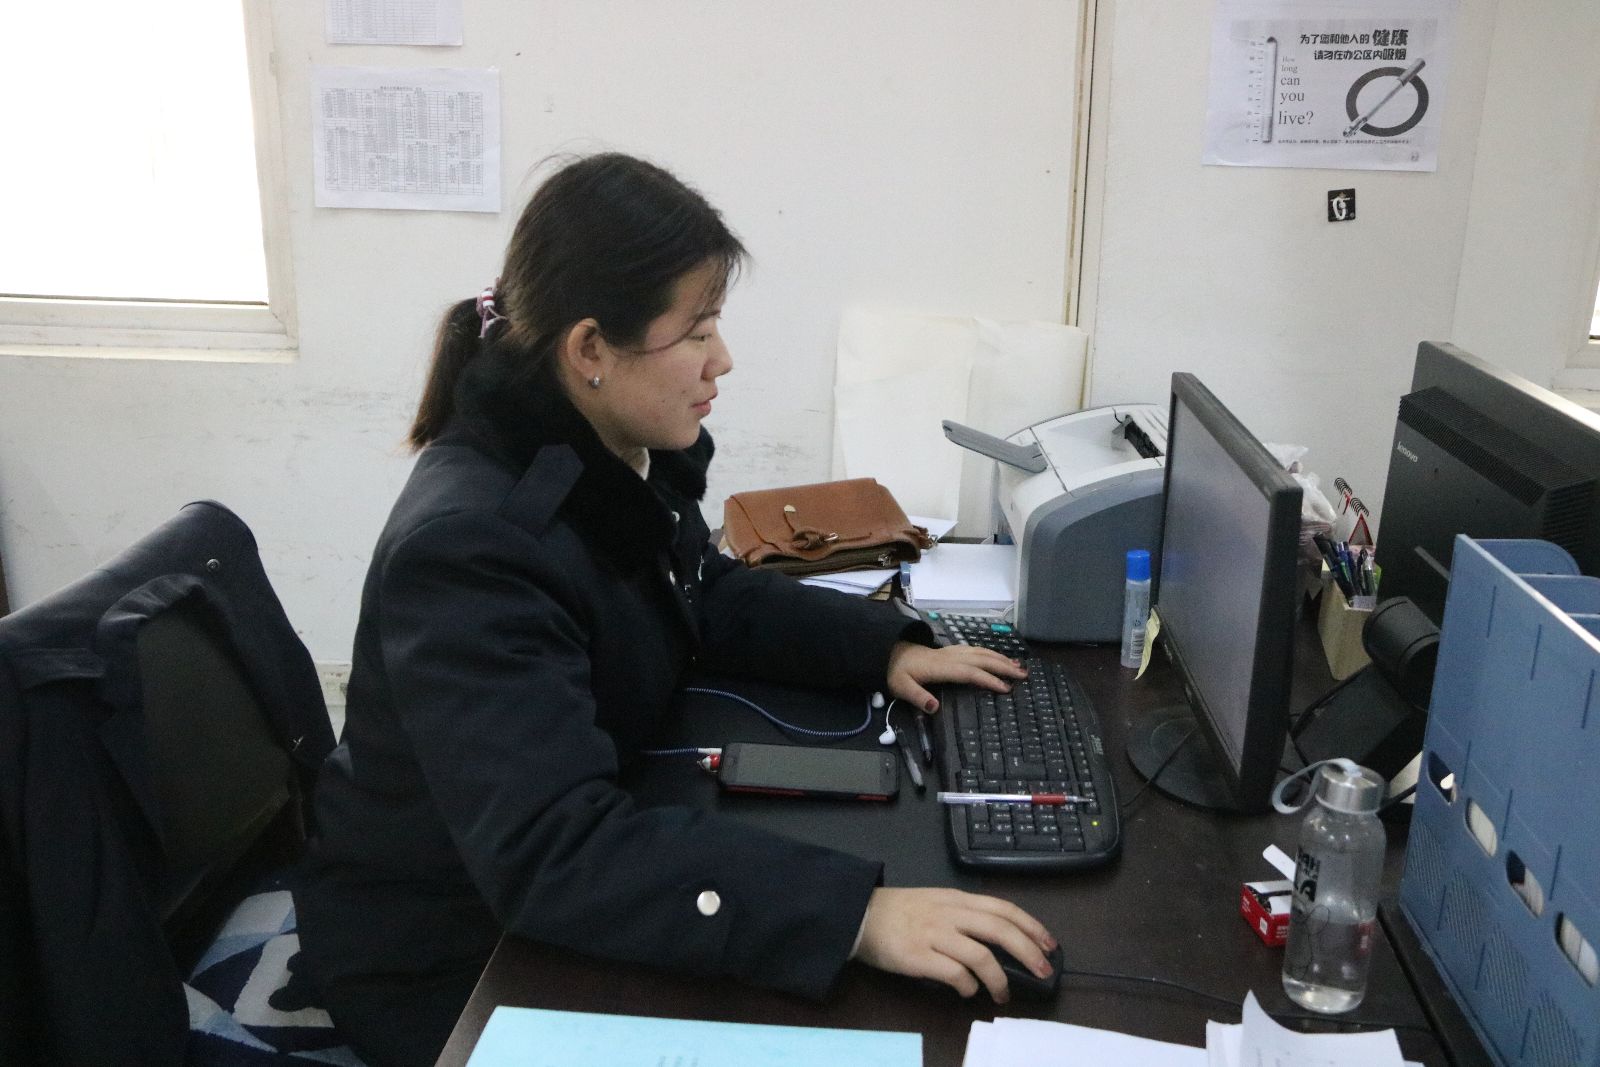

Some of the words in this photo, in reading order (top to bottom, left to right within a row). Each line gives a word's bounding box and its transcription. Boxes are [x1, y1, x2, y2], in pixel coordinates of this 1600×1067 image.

[1314, 48, 1407, 60] 请勿在办公区内吸烟
[1281, 65, 1298, 74] long
[1280, 77, 1301, 86] can
[1280, 92, 1305, 105] you
[1279, 111, 1314, 125] live?
